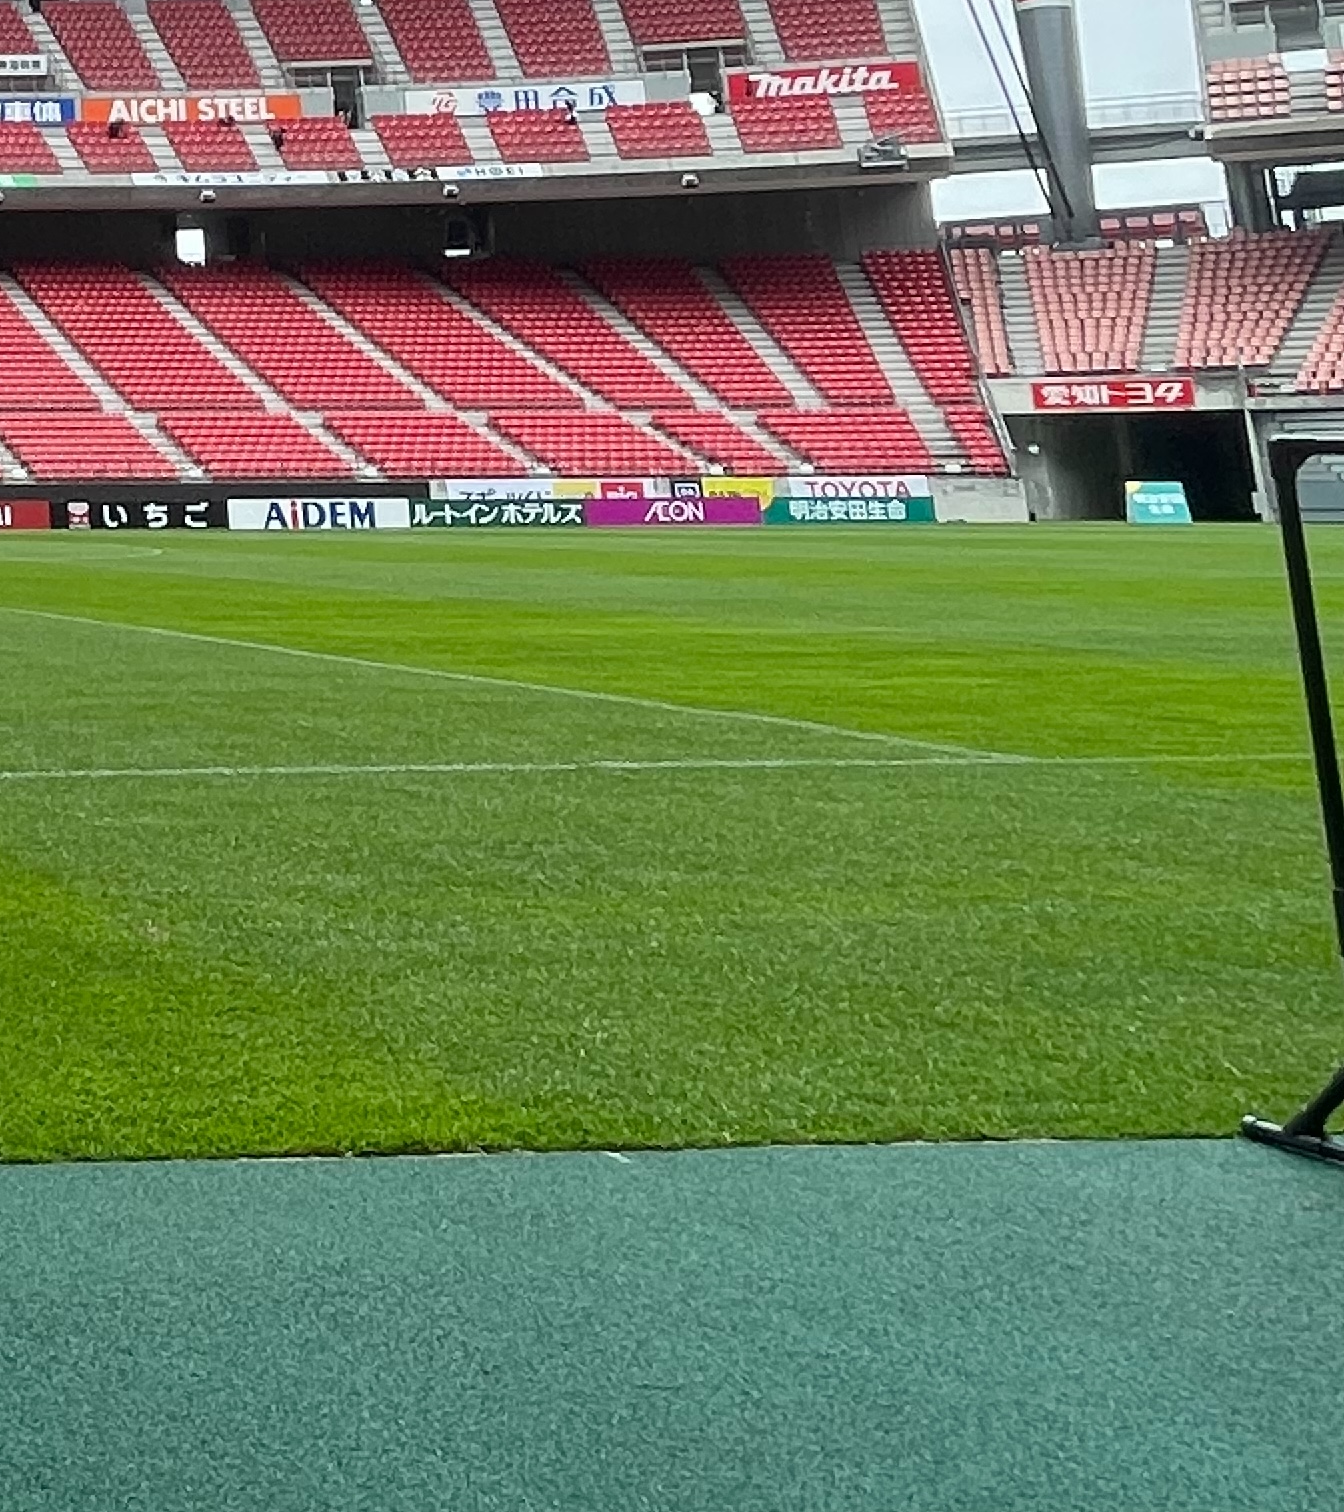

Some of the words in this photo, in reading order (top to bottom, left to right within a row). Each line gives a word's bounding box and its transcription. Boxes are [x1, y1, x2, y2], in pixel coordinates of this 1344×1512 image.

[107, 99, 168, 122] AICHI
[197, 97, 276, 120] STEEL
[102, 502, 210, 528] いちご
